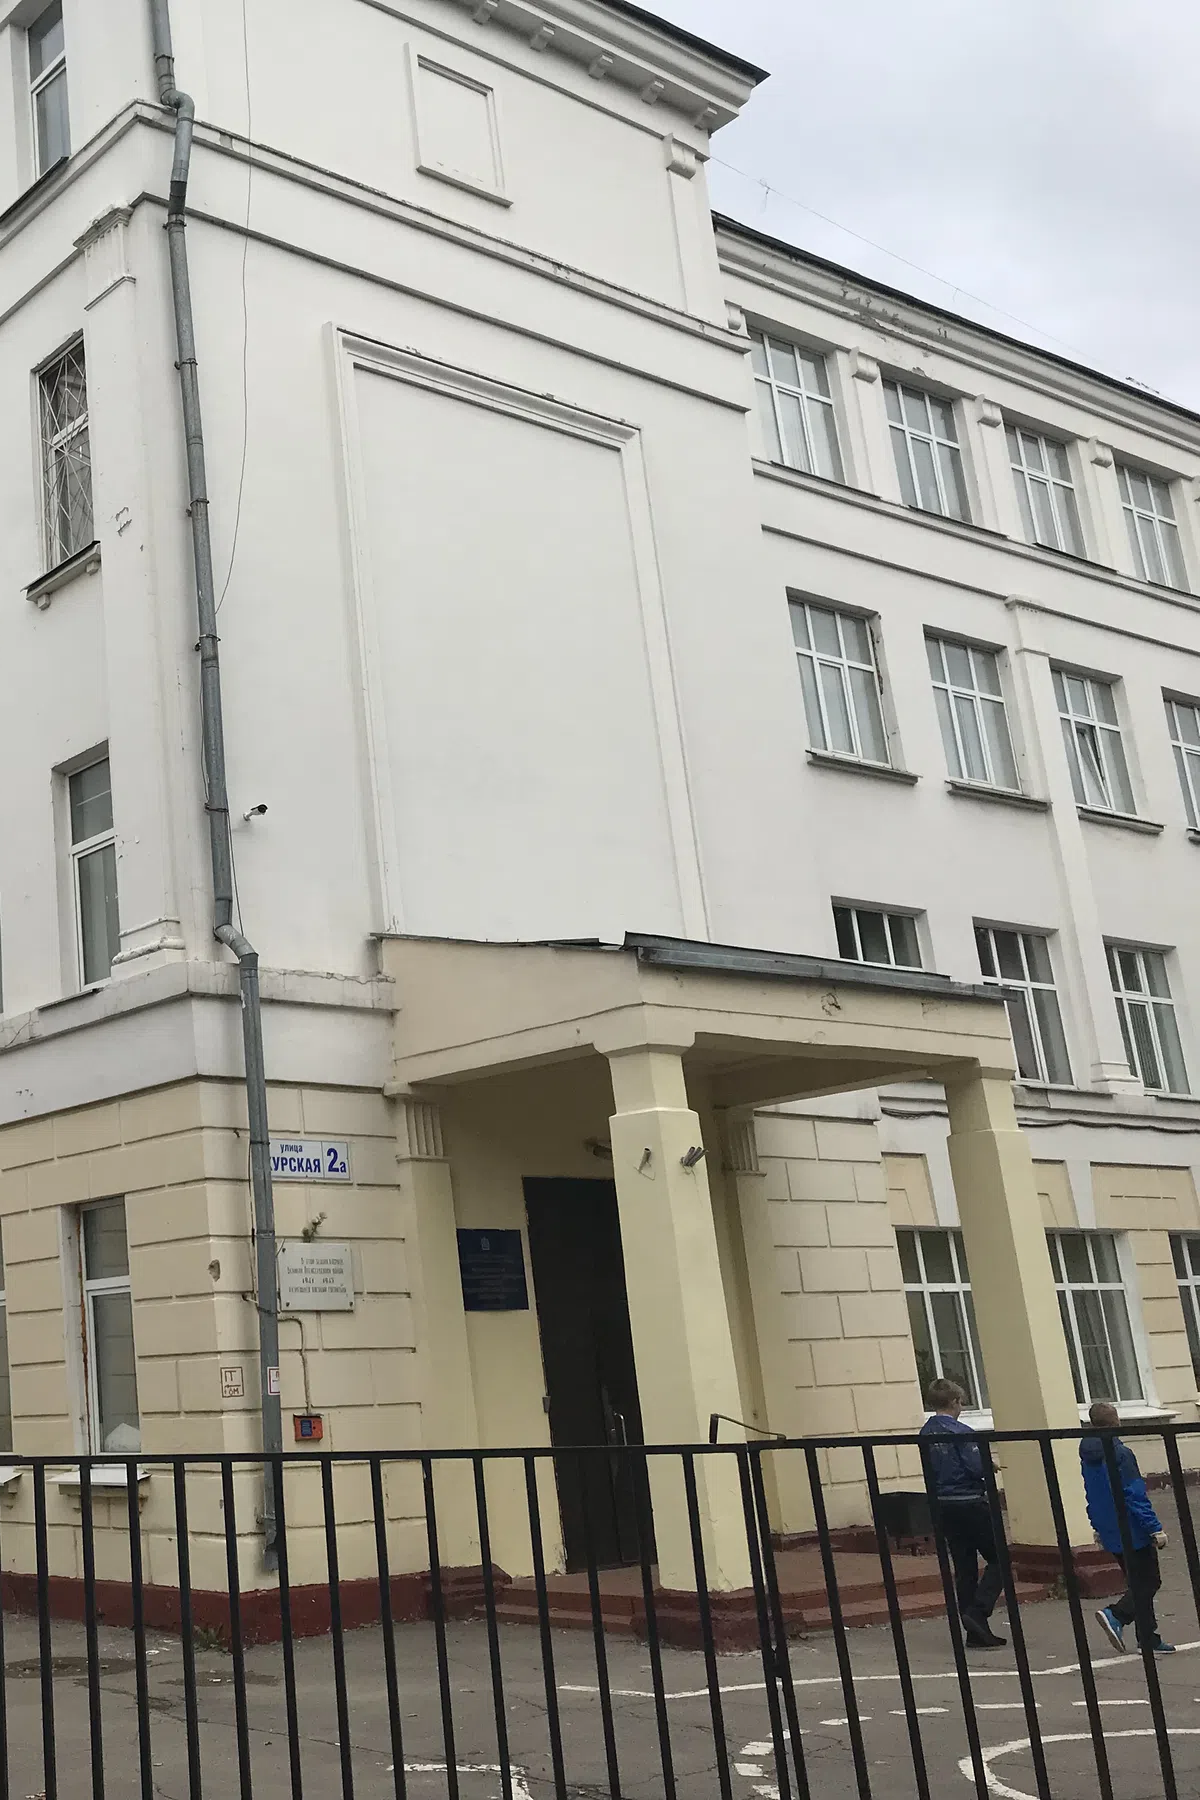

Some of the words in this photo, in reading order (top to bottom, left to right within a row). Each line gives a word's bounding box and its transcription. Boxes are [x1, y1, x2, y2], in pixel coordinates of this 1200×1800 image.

[280, 1143, 303, 1153] улица
[270, 1156, 321, 1173] УРСКАЯ
[326, 1147, 347, 1173] 2а
